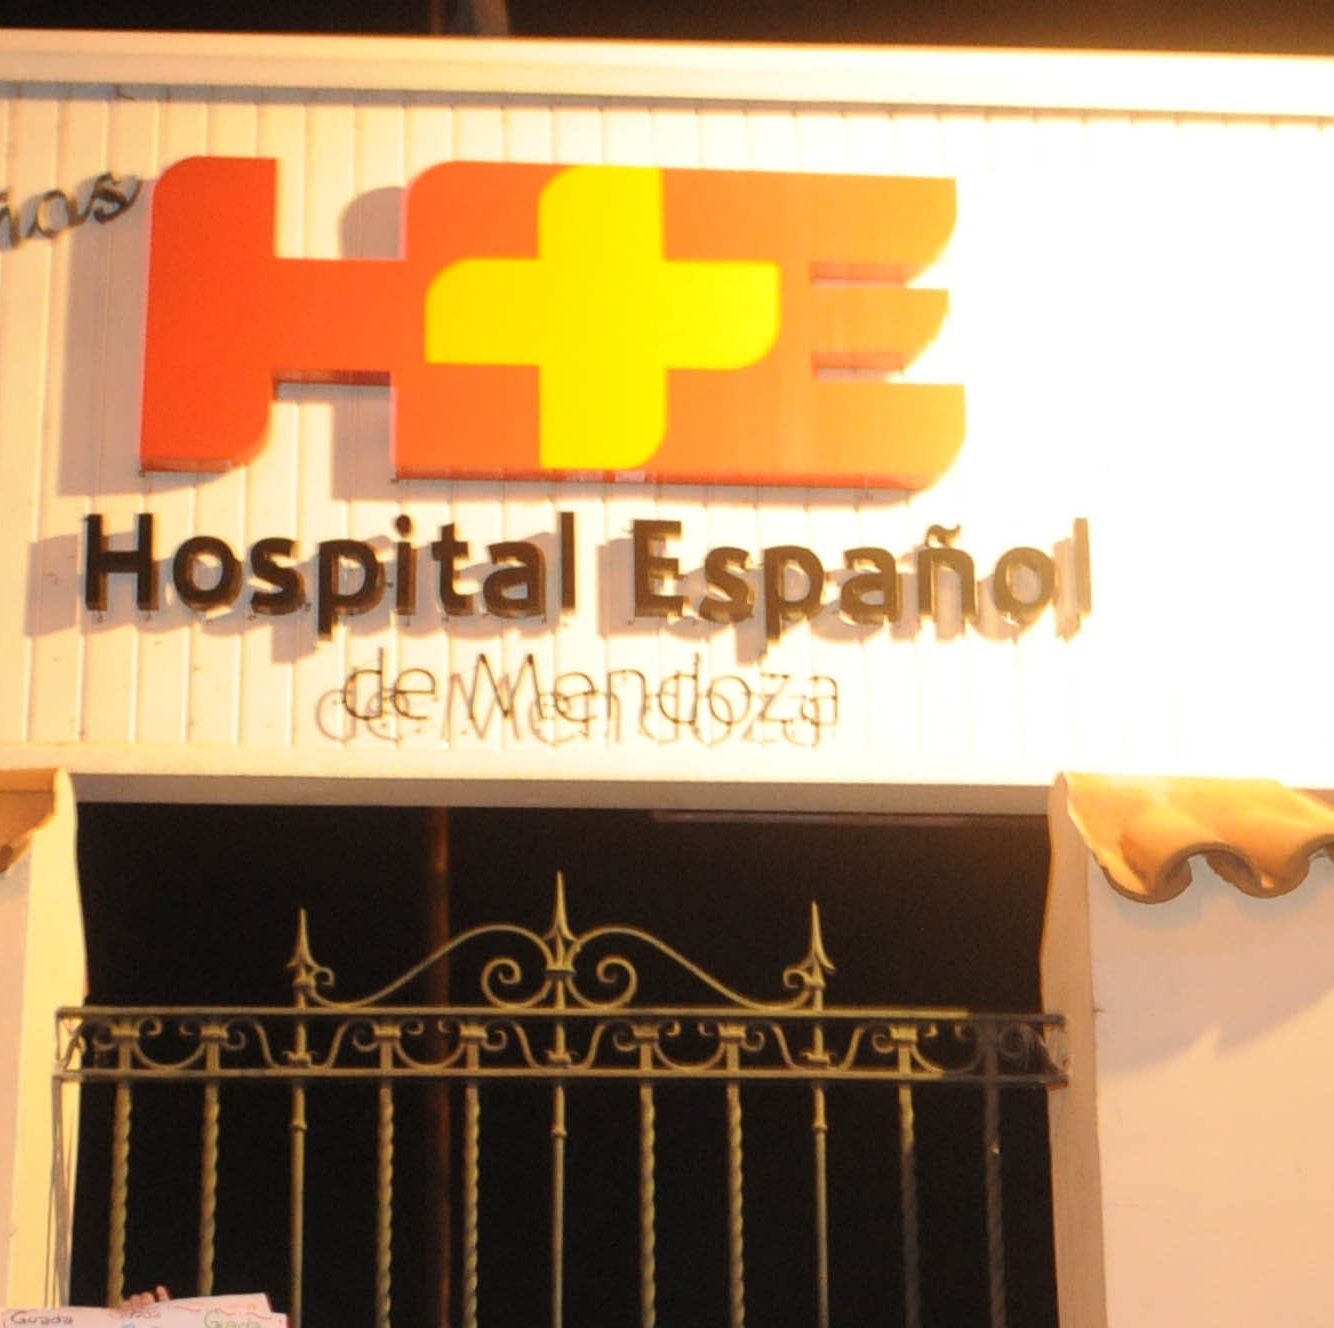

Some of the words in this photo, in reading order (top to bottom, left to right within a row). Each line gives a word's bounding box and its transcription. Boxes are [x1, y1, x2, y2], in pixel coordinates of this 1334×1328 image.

[83, 512, 577, 642] Hospital
[629, 516, 1091, 644] Español
[342, 648, 437, 722] de
[469, 652, 839, 728] Mendoza
